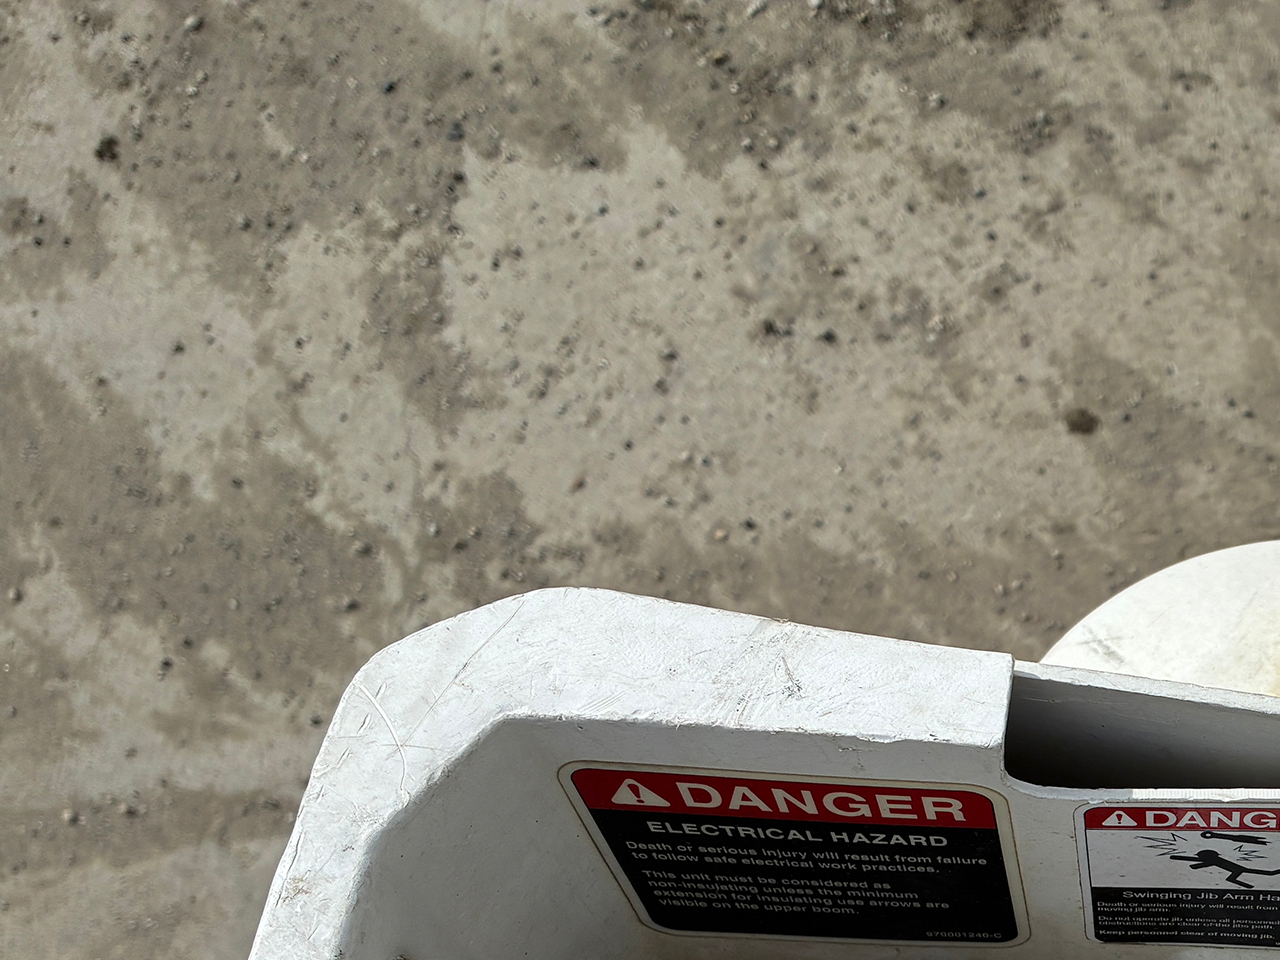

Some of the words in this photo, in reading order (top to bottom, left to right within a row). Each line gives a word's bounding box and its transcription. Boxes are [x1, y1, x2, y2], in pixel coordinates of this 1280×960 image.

[675, 782, 967, 822] DANGER
[646, 821, 823, 842] ELECTRICAL
[830, 832, 948, 847] HAZARD
[626, 841, 672, 851] Death
[677, 844, 692, 852] or
[698, 846, 757, 856] serious
[762, 848, 807, 860] injury
[812, 852, 839, 860] will
[845, 853, 890, 862] result
[895, 854, 931, 863] from
[936, 856, 987, 865] failure
[652, 853, 699, 862] follow
[704, 855, 737, 864] safe
[741, 858, 813, 868] electrical
[817, 862, 857, 870] work
[862, 865, 940, 873] practices.
[642, 870, 676, 879] This
[681, 873, 711, 881] unit
[715, 875, 753, 883] must
[781, 879, 868, 888] considered
[648, 880, 758, 894] non-insulating
[763, 886, 813, 895] unless
[818, 888, 842, 896] the
[847, 891, 918, 899] minimum
[653, 889, 727, 899] extension
[731, 892, 751, 901] for
[757, 895, 832, 906] insulating
[1122, 891, 1192, 900] Swinging
[659, 898, 707, 907] visible
[735, 902, 759, 910] the
[764, 905, 807, 913] upper
[812, 906, 859, 914] boom.
